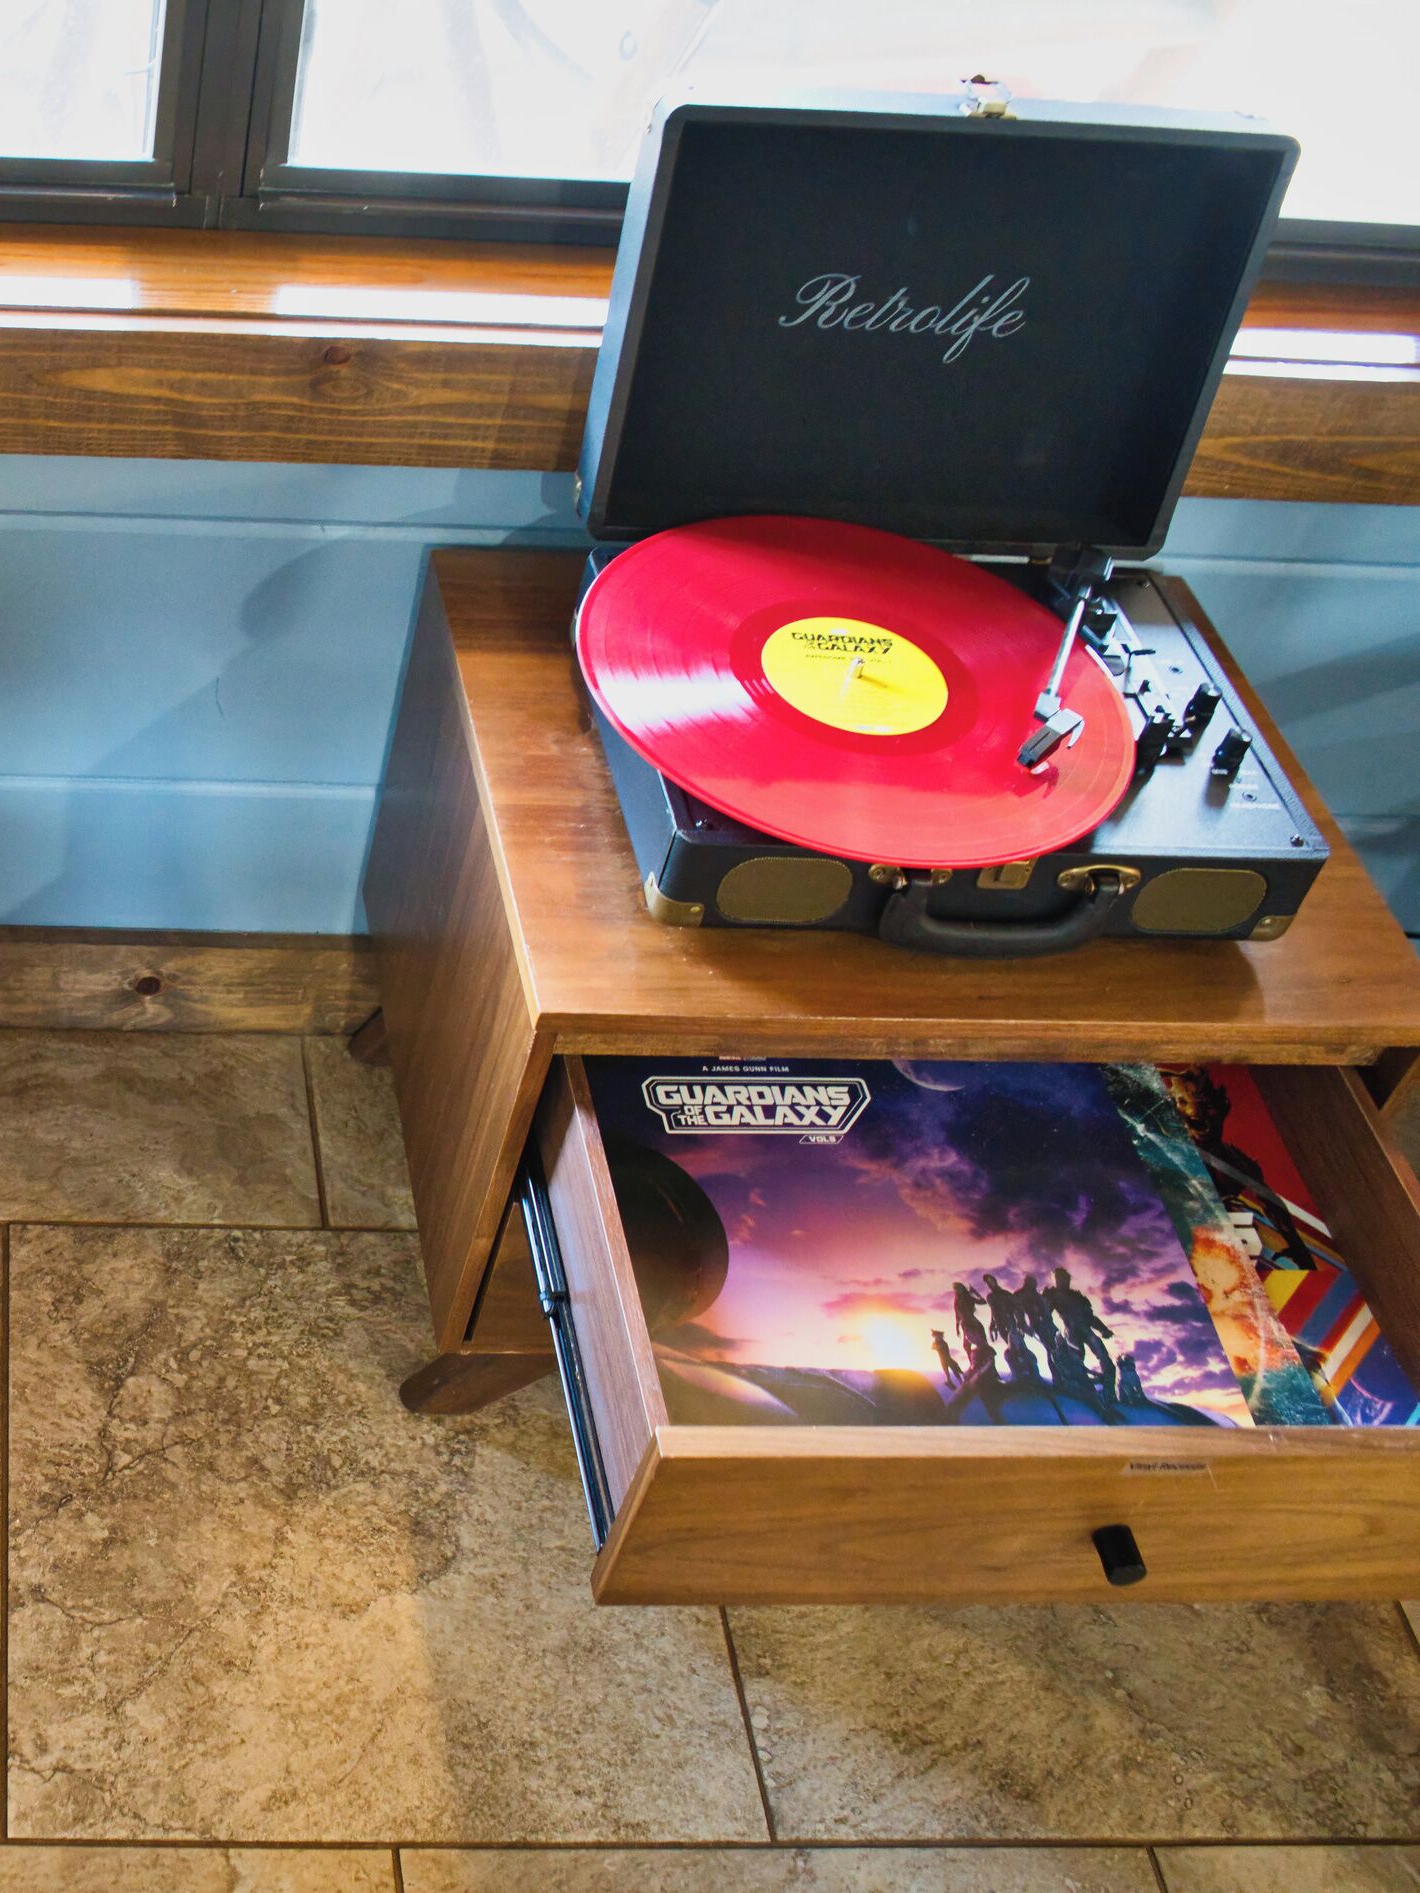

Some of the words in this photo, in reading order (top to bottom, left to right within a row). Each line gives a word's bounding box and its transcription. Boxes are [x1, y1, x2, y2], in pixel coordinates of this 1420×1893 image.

[777, 272, 1031, 365] Retrolife
[656, 1084, 851, 1106] GUARDIANS
[677, 1115, 707, 1125] THE
[704, 1105, 848, 1126] GALAXY
[684, 1105, 704, 1115] OF
